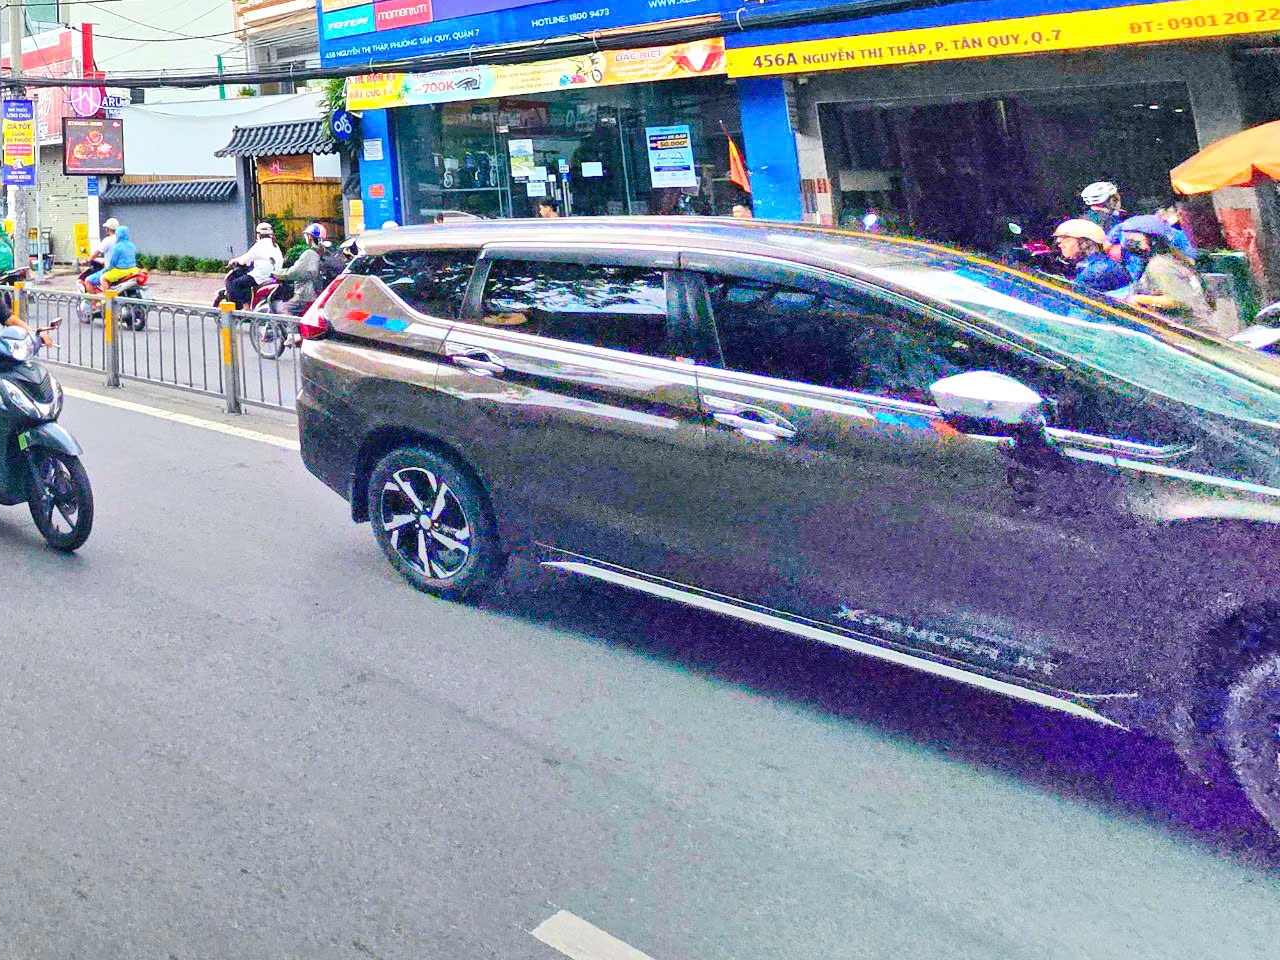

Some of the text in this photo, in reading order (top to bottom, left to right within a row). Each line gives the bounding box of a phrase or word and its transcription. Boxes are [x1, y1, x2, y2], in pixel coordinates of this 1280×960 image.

[569, 12, 588, 22] 1800
[589, 8, 610, 18] 9473
[1168, 14, 1220, 31] 0901
[1223, 11, 1249, 26] 20
[475, 28, 481, 37] 7
[752, 51, 799, 69] 456A
[858, 46, 884, 60] THỊ
[935, 41, 949, 53] P.
[952, 36, 983, 50] TÂN
[422, 80, 455, 94] 700K
